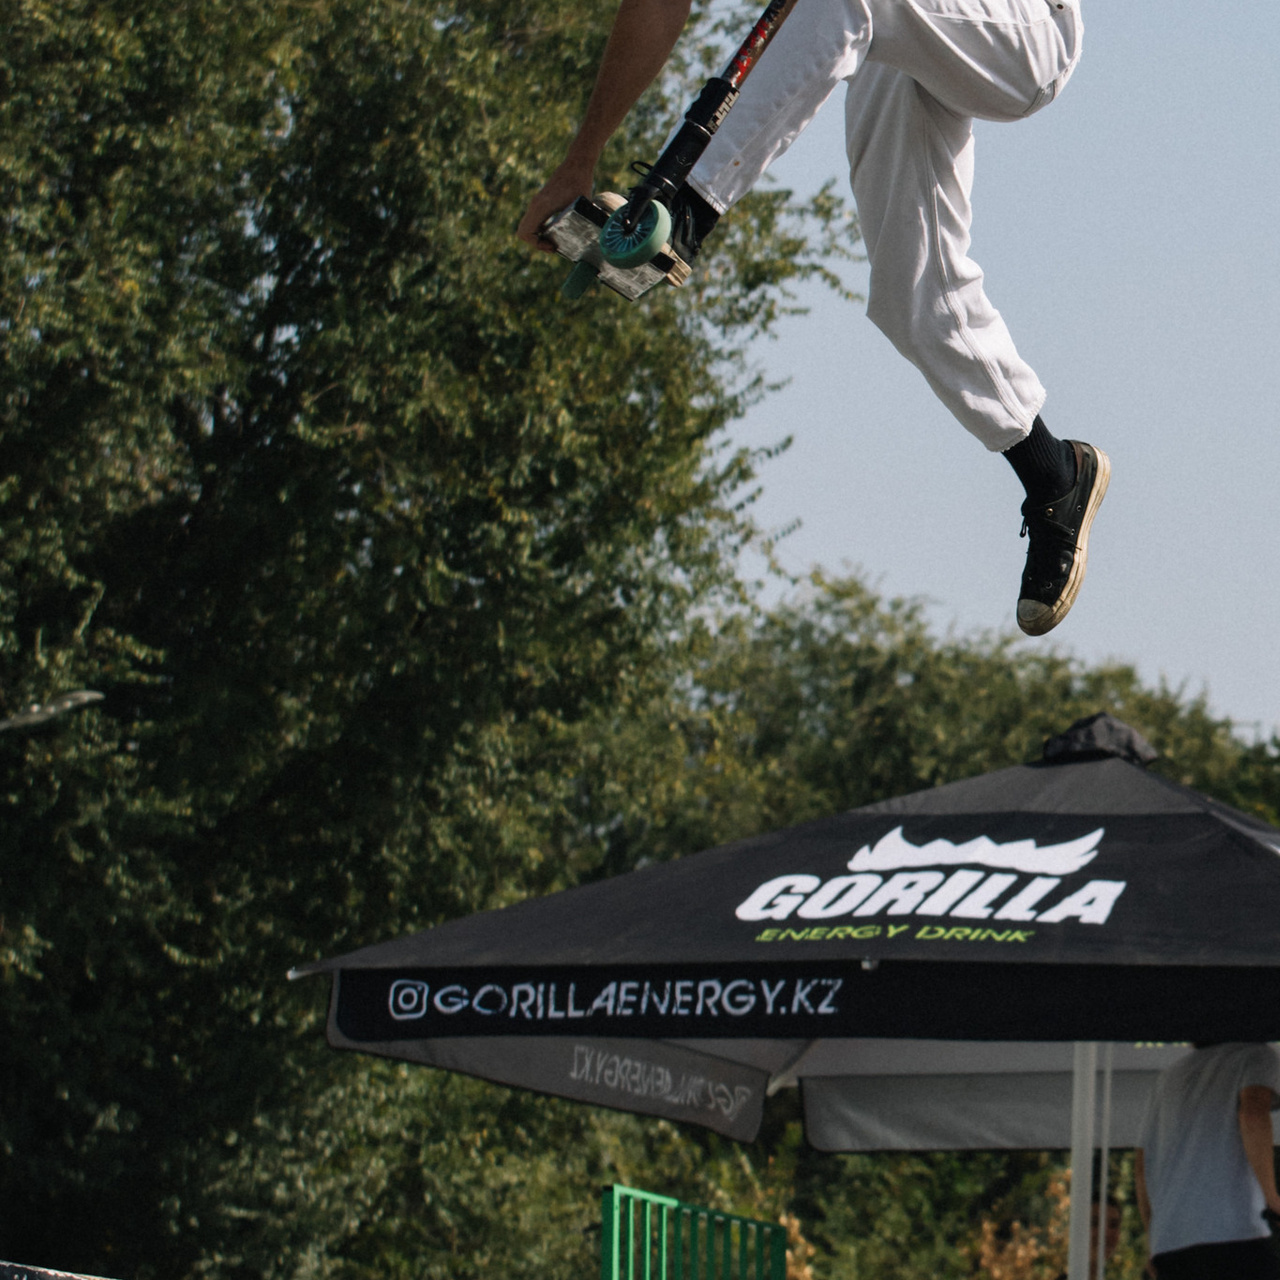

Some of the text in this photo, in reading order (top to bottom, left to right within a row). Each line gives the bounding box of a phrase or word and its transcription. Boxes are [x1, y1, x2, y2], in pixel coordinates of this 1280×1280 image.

[711, 90, 740, 127] TILT
[735, 868, 1128, 926] GORILLA
[755, 924, 1036, 943] ENERGY DRINK
[433, 978, 844, 1018] GORILLAENERGY.KZ
